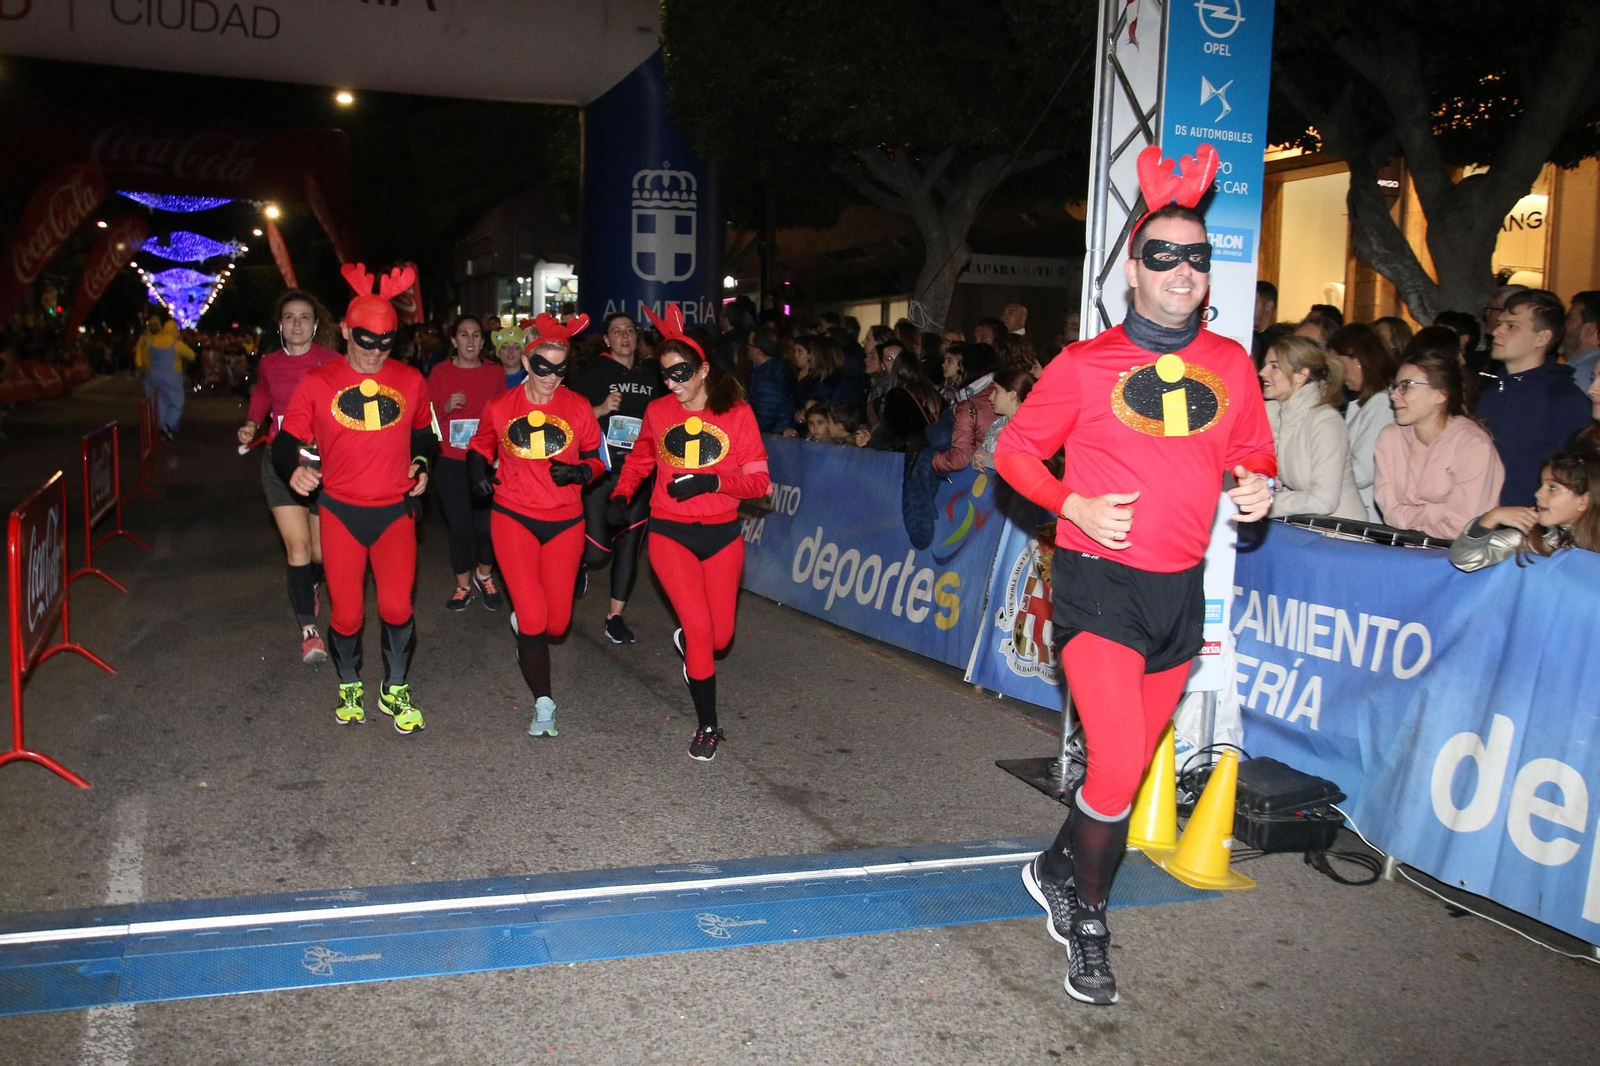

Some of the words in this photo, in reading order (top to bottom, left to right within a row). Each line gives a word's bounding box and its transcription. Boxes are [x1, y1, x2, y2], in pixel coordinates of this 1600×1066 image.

[110, 0, 281, 39] CIUDAD
[1203, 41, 1232, 57] OPEL
[1174, 124, 1188, 137] DS
[1190, 126, 1253, 144] AUTOMOBILES
[1223, 181, 1249, 195] CAR
[609, 383, 653, 396] SWEAT
[792, 525, 961, 631] deportes
[1013, 661, 1035, 673] CIUDAD
